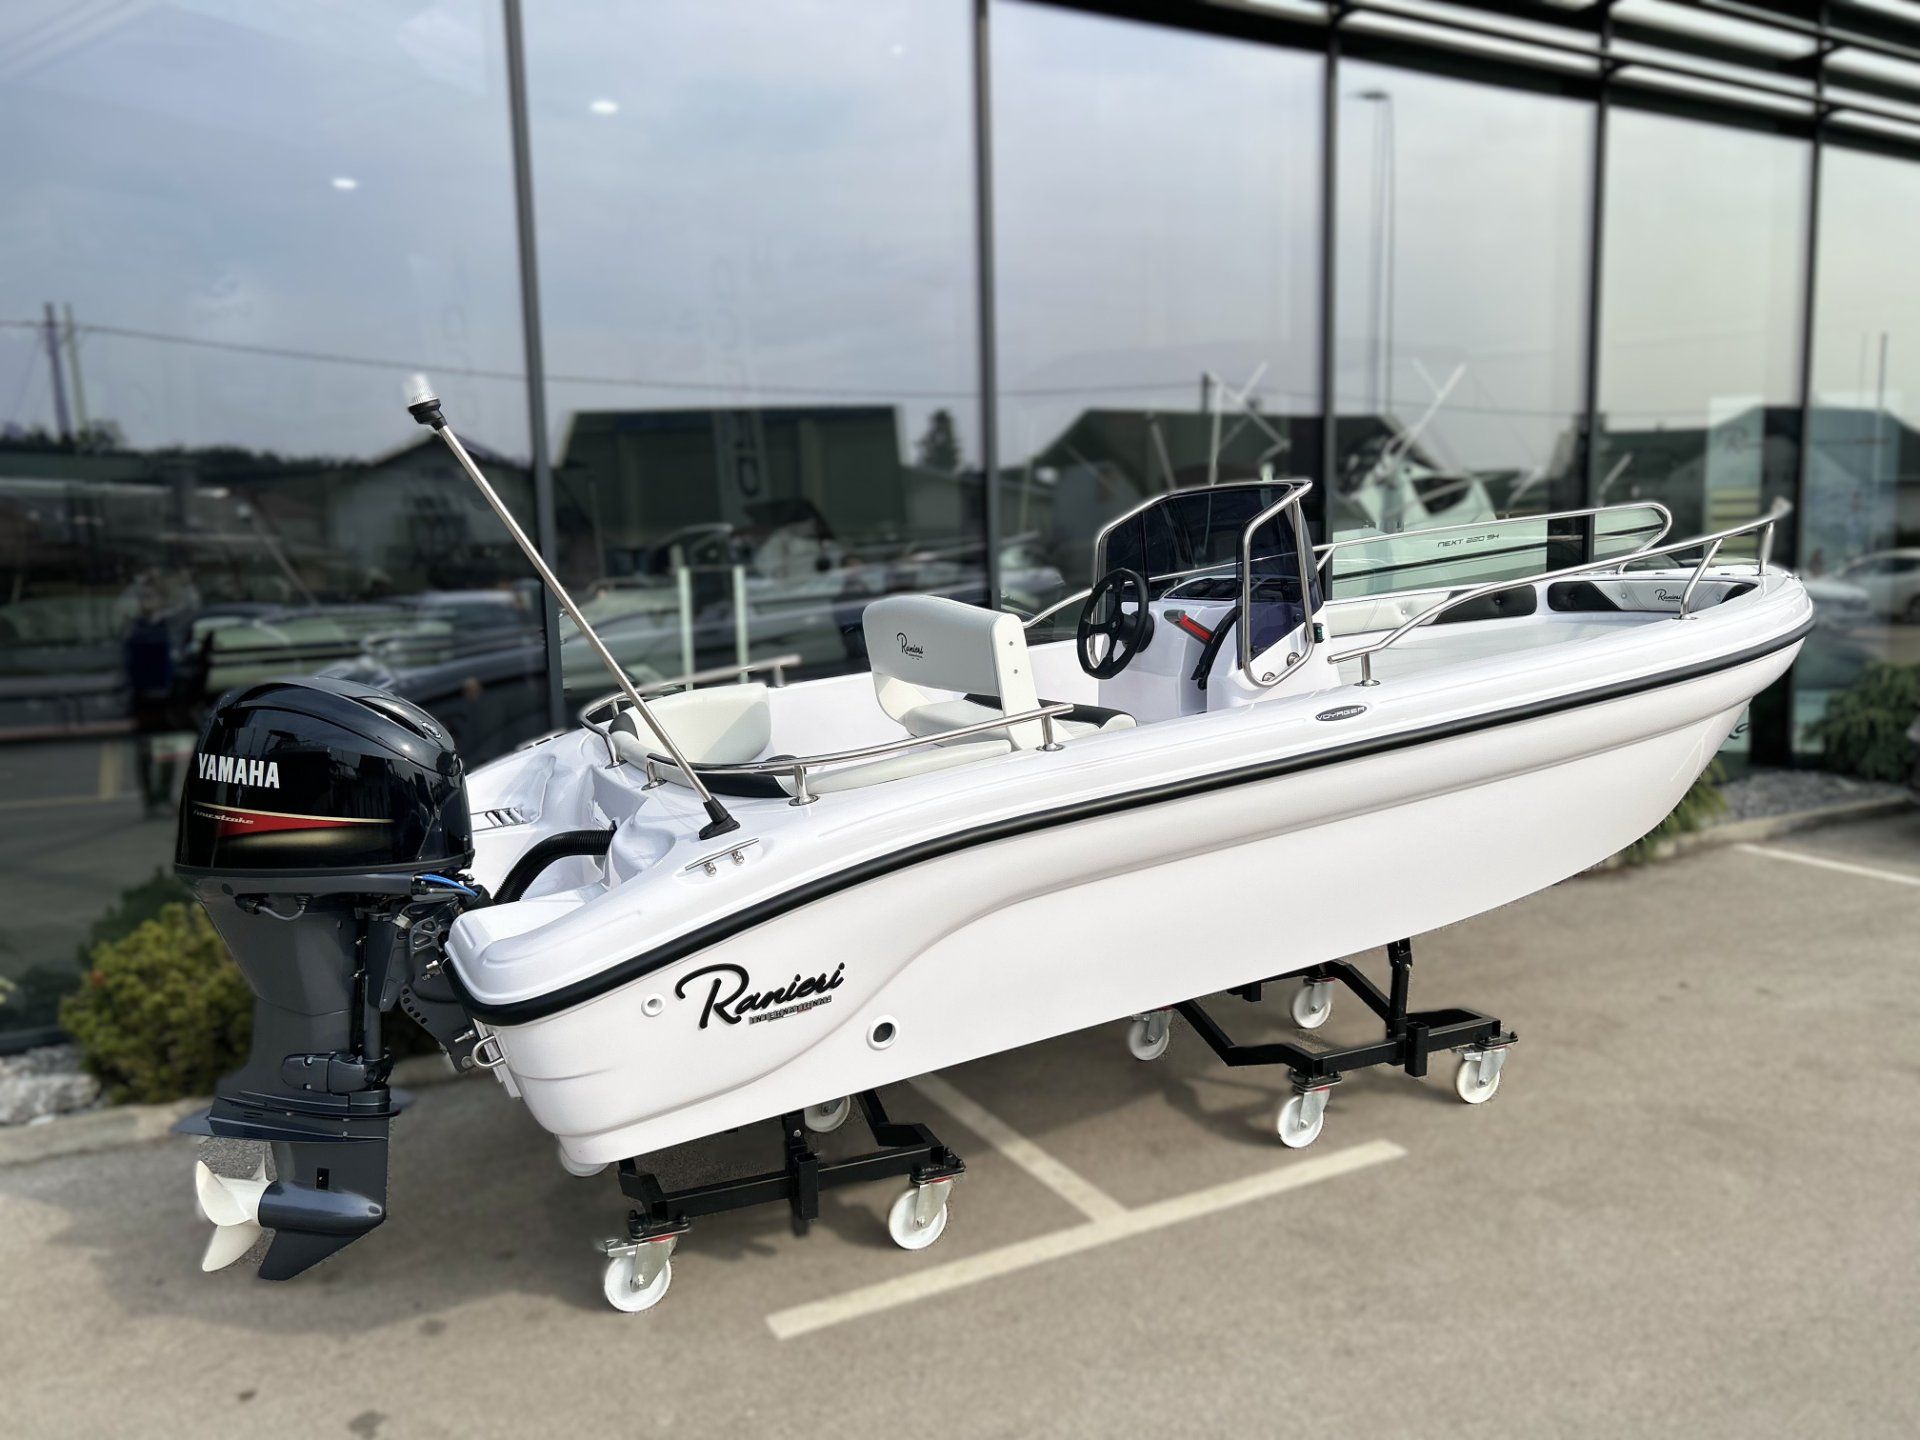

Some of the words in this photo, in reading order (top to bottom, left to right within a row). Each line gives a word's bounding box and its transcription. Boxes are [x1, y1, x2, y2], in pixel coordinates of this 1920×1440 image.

[1437, 539, 1463, 548] NEXT
[1466, 535, 1485, 544] 220
[896, 632, 924, 655] Ranieri
[1316, 706, 1365, 720] VOYAGER
[198, 752, 280, 789] YAMAHA
[674, 962, 845, 1029] Ranieri
[749, 995, 832, 1025] INTERNATIONAL
